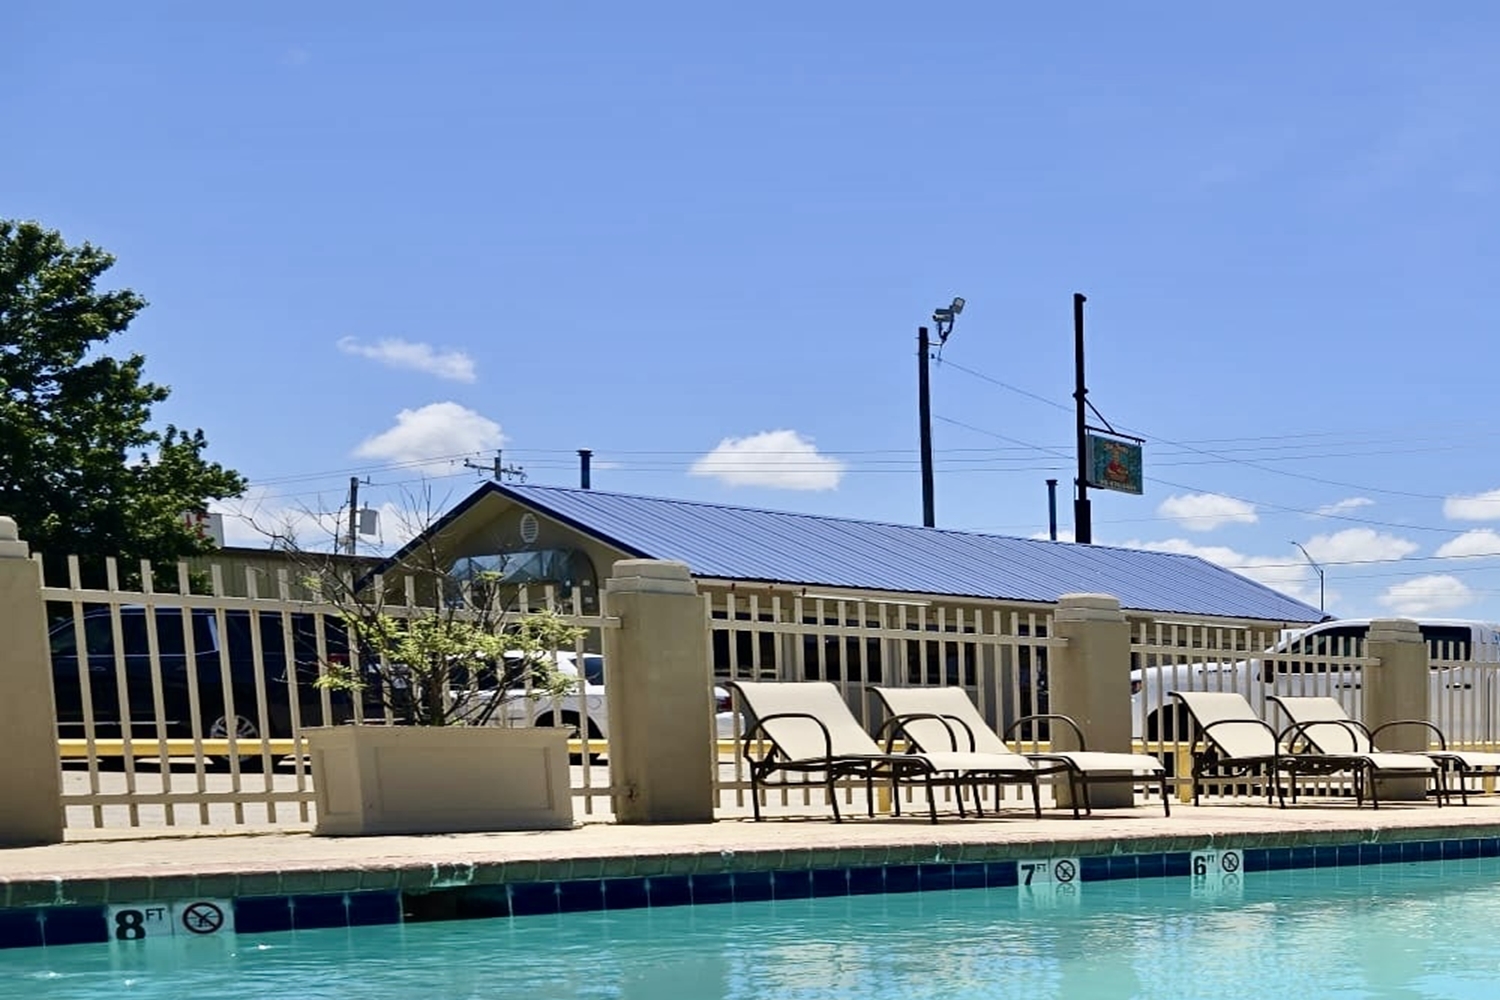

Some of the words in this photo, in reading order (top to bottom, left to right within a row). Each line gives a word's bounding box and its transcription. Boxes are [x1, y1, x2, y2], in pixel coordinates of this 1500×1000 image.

[1020, 864, 1036, 886] 7
[1036, 863, 1047, 873] FT
[1193, 855, 1207, 875] 6
[115, 909, 146, 940] 8
[145, 908, 165, 921] FT
